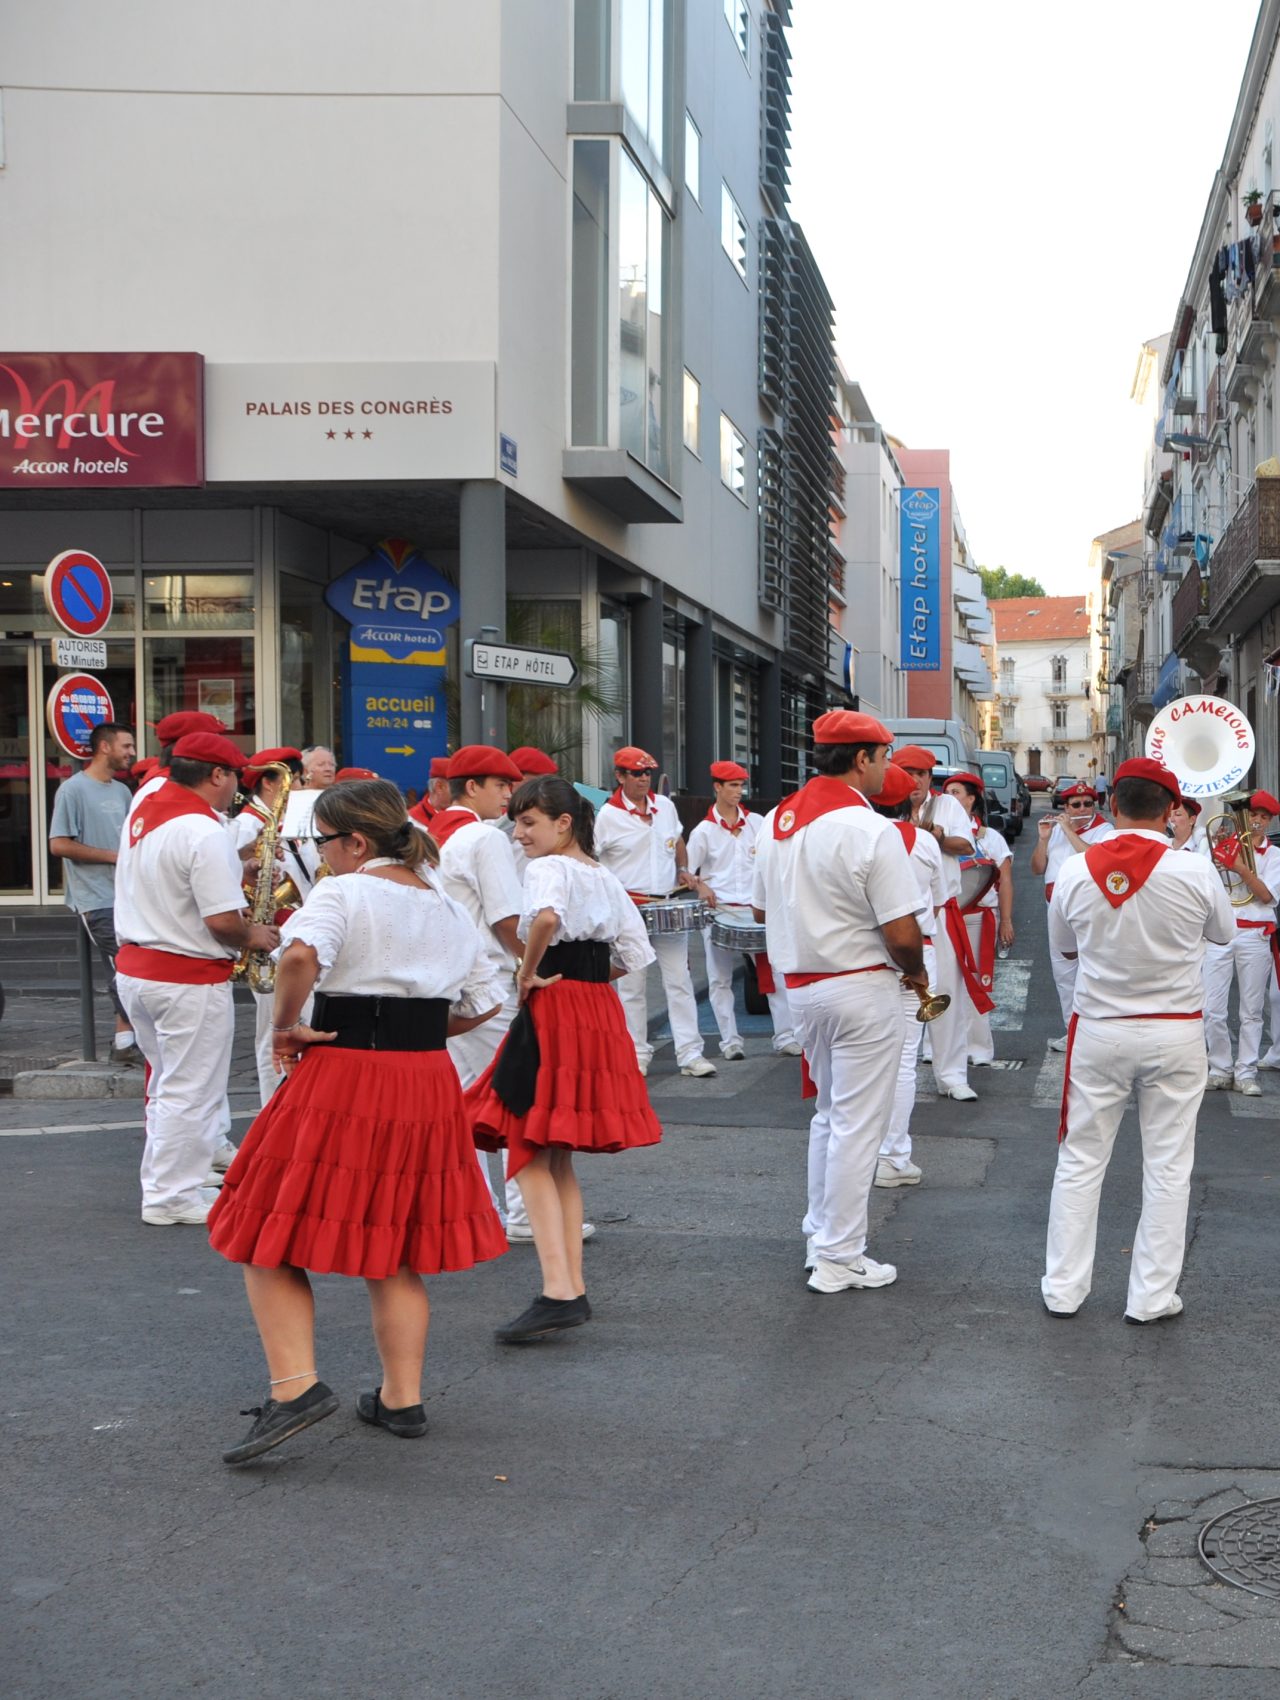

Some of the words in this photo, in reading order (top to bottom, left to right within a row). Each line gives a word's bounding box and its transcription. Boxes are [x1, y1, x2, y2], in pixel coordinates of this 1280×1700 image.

[246, 401, 312, 415] PALAIS
[318, 401, 354, 415] DES
[361, 396, 453, 415] CONGRÈS
[74, 457, 128, 474] hotels
[910, 522, 928, 589] hotel
[353, 578, 450, 620] Etap
[908, 597, 932, 659] Etap
[59, 640, 104, 653] AUTORISE
[404, 635, 436, 644] hotels
[59, 655, 68, 665] 15
[71, 655, 105, 668] Minutes
[495, 655, 519, 670] ETAP
[525, 658, 555, 675] HÔTEL
[366, 696, 434, 712] accueil
[1151, 727, 1167, 767] OUS
[1180, 766, 1243, 793] EZIERS
